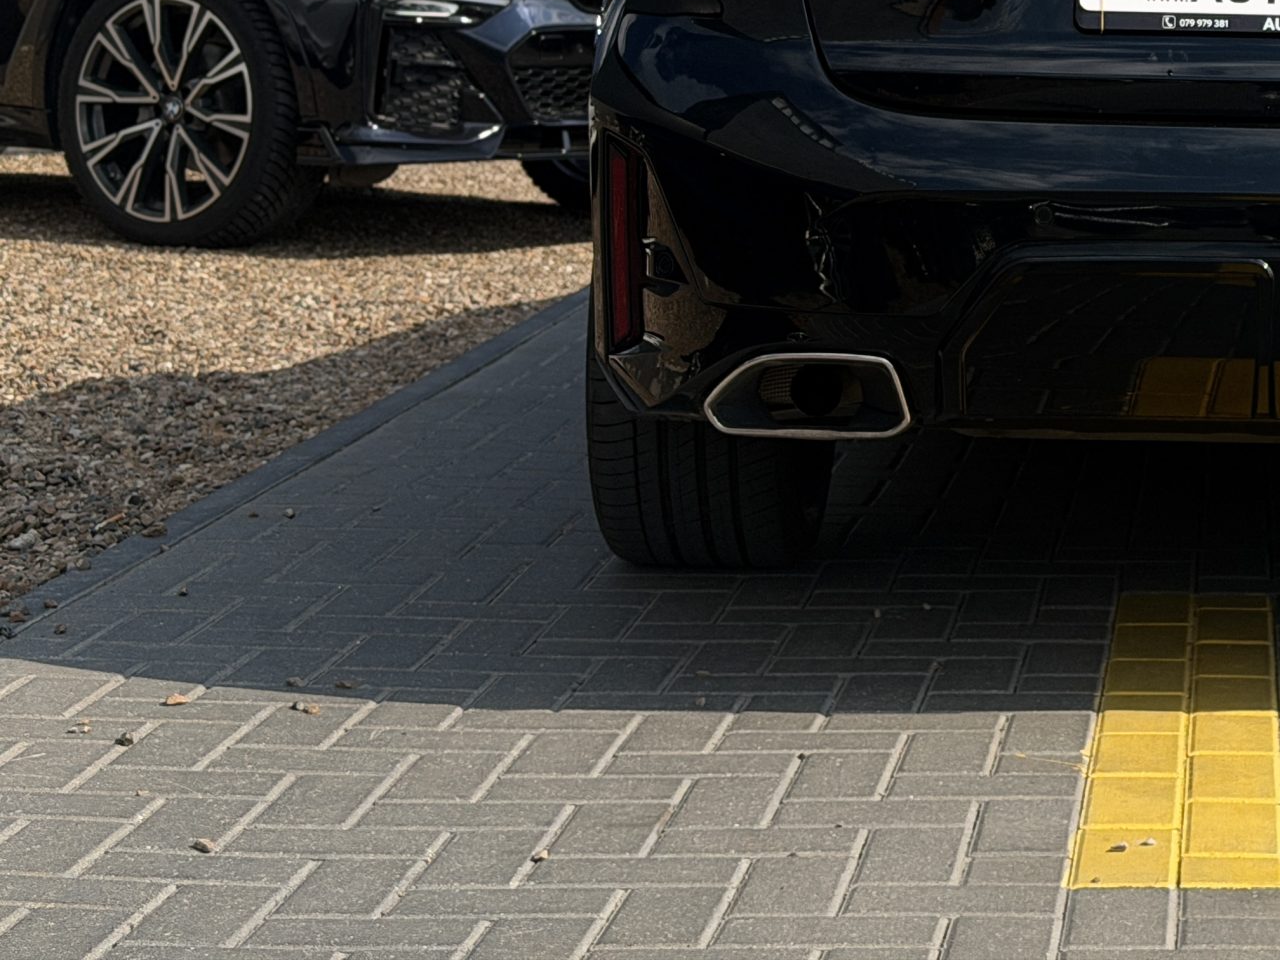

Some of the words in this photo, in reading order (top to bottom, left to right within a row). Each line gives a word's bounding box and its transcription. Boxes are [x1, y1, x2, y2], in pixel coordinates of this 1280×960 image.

[1179, 17, 1195, 28] 079
[1197, 18, 1212, 28] 979
[1213, 19, 1229, 28] 381
